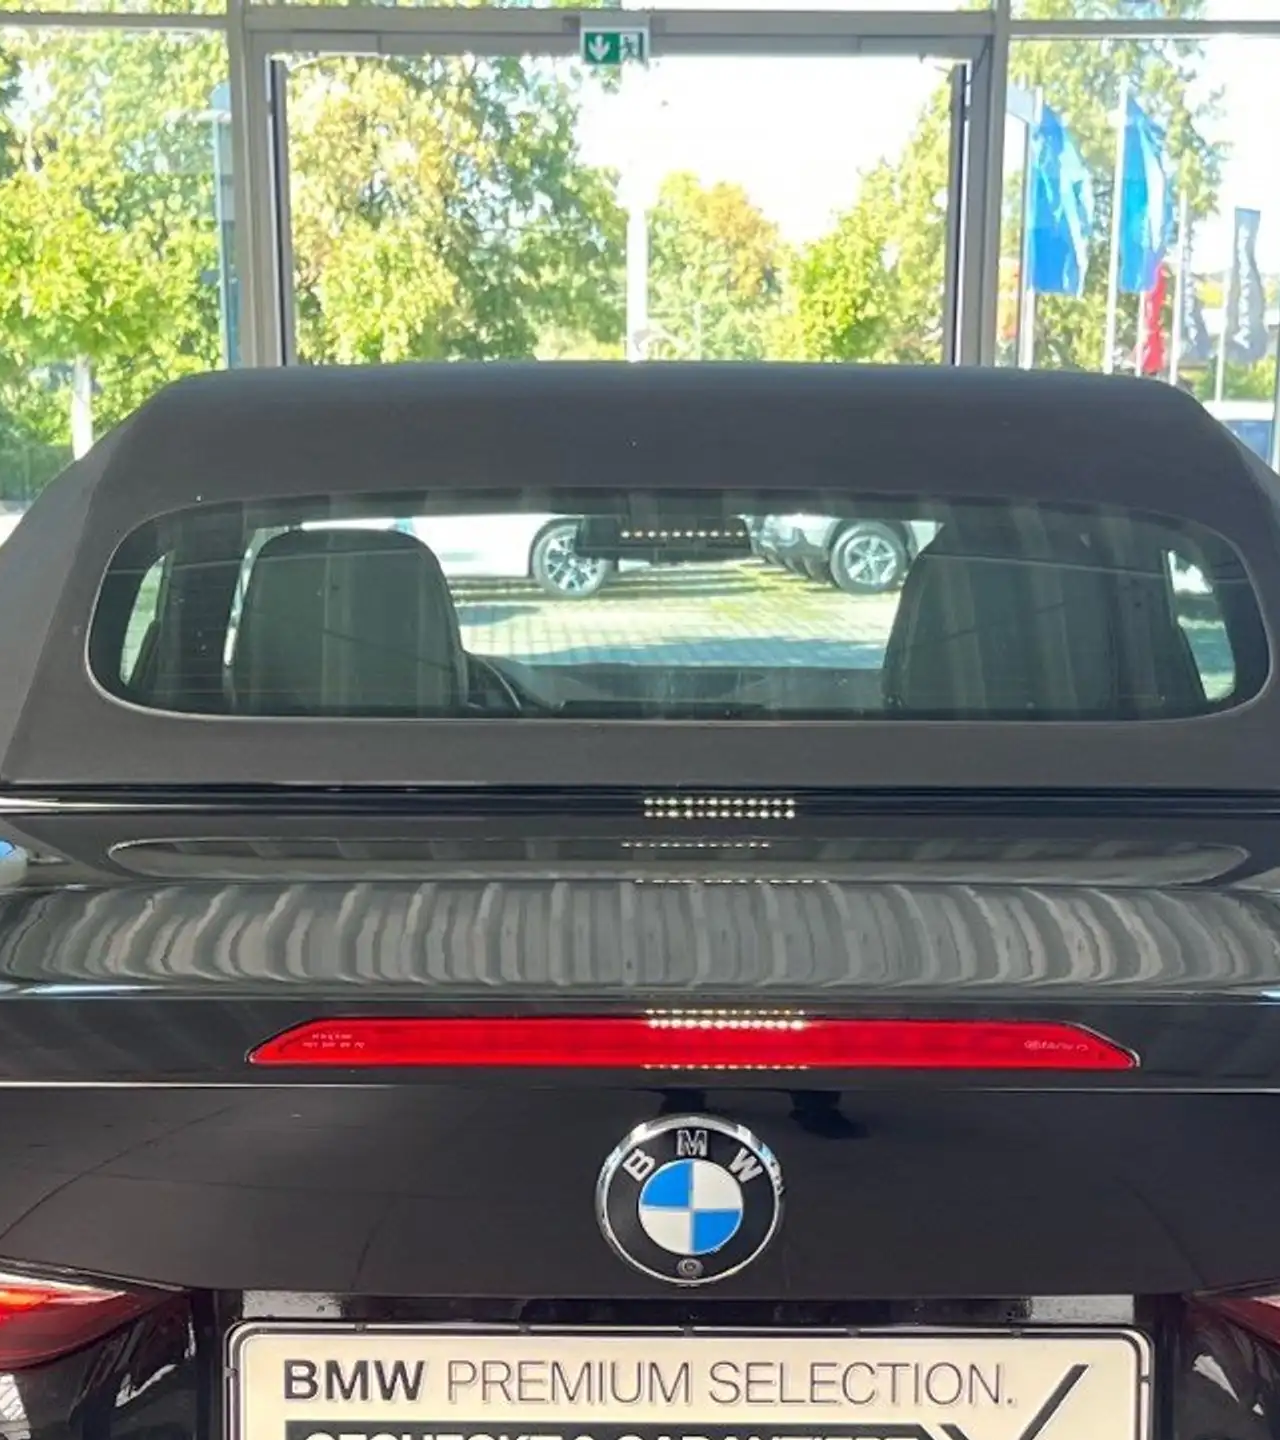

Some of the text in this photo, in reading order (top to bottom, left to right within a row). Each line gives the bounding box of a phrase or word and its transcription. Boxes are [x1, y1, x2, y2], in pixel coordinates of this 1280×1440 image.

[622, 1129, 763, 1184] BMW
[283, 1359, 1015, 1406] BMW PREMIUM SELECTION.
